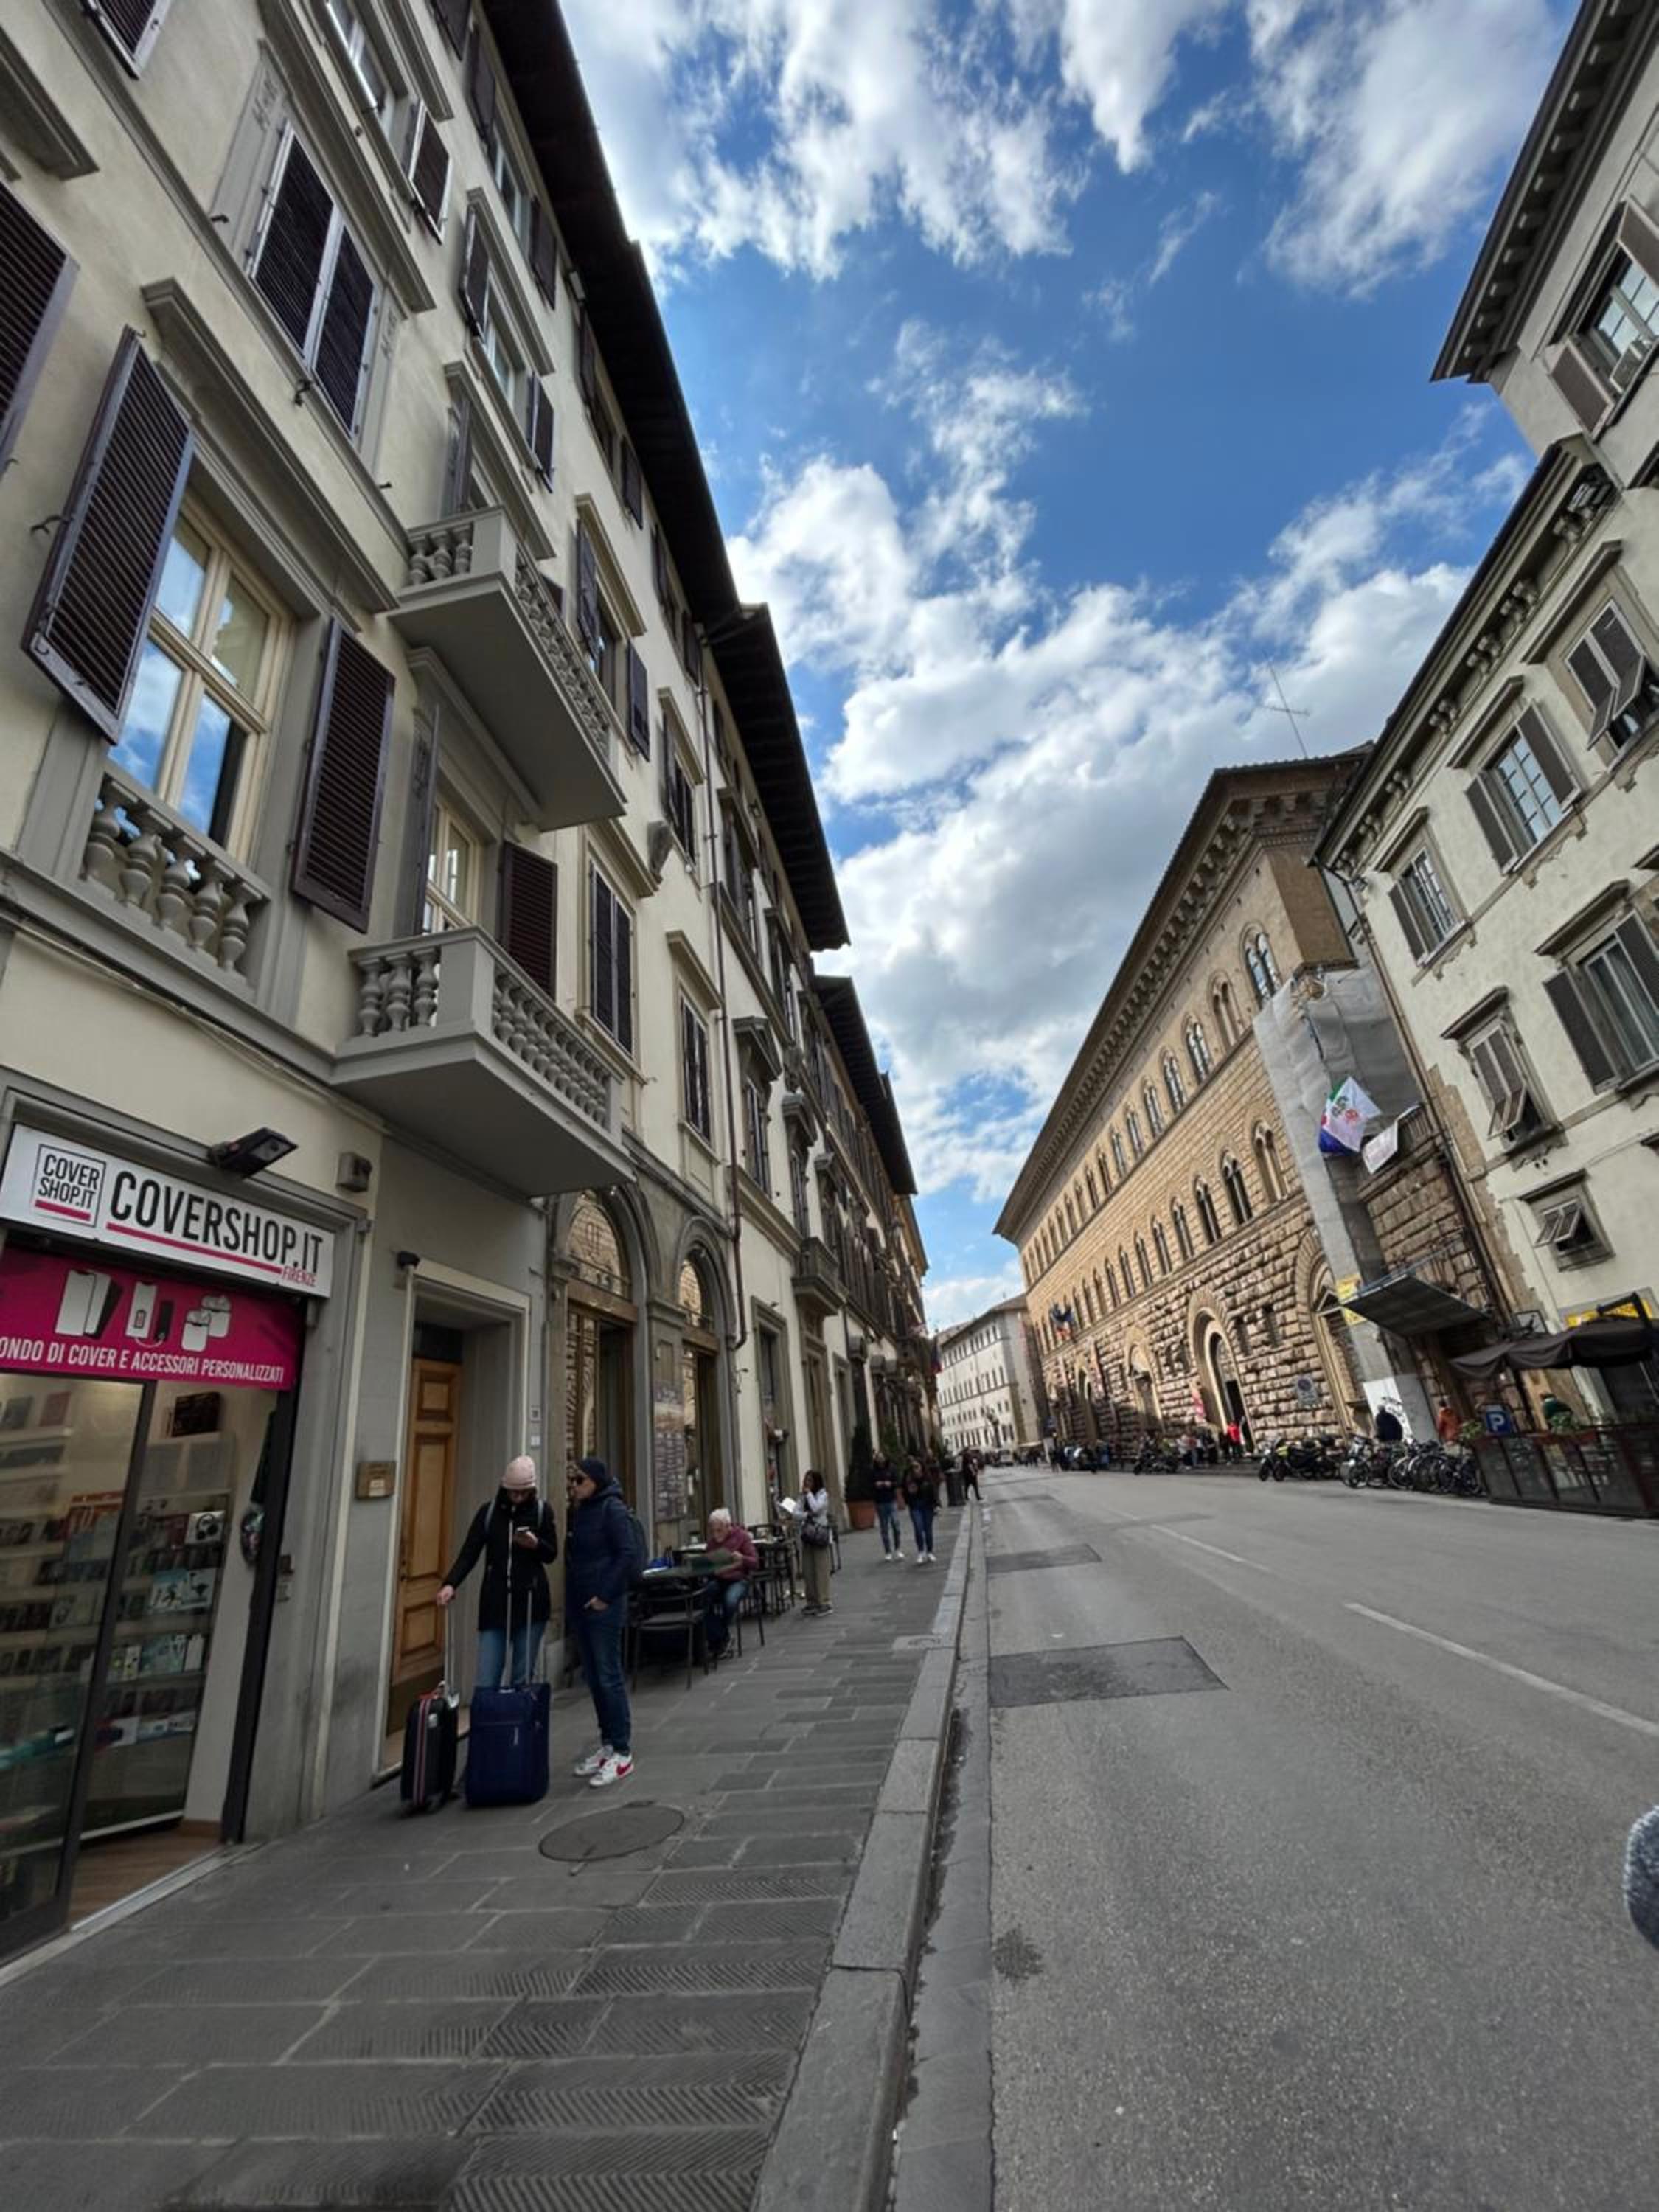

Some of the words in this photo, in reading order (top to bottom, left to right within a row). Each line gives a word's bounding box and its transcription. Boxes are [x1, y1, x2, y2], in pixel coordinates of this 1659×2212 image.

[43, 1154, 100, 1190] COVER
[38, 1176, 96, 1209] SHOP.IT
[110, 1170, 323, 1273] COVERSHOP.IT
[282, 1265, 317, 1287] FIRENZE
[47, 1342, 65, 1363] DI
[68, 1344, 117, 1369] COVER
[119, 1349, 130, 1370] E
[131, 1351, 200, 1376] ACCESSORI
[200, 1358, 285, 1383] PERSONALIZZATI
[1489, 1413, 1505, 1432] P
